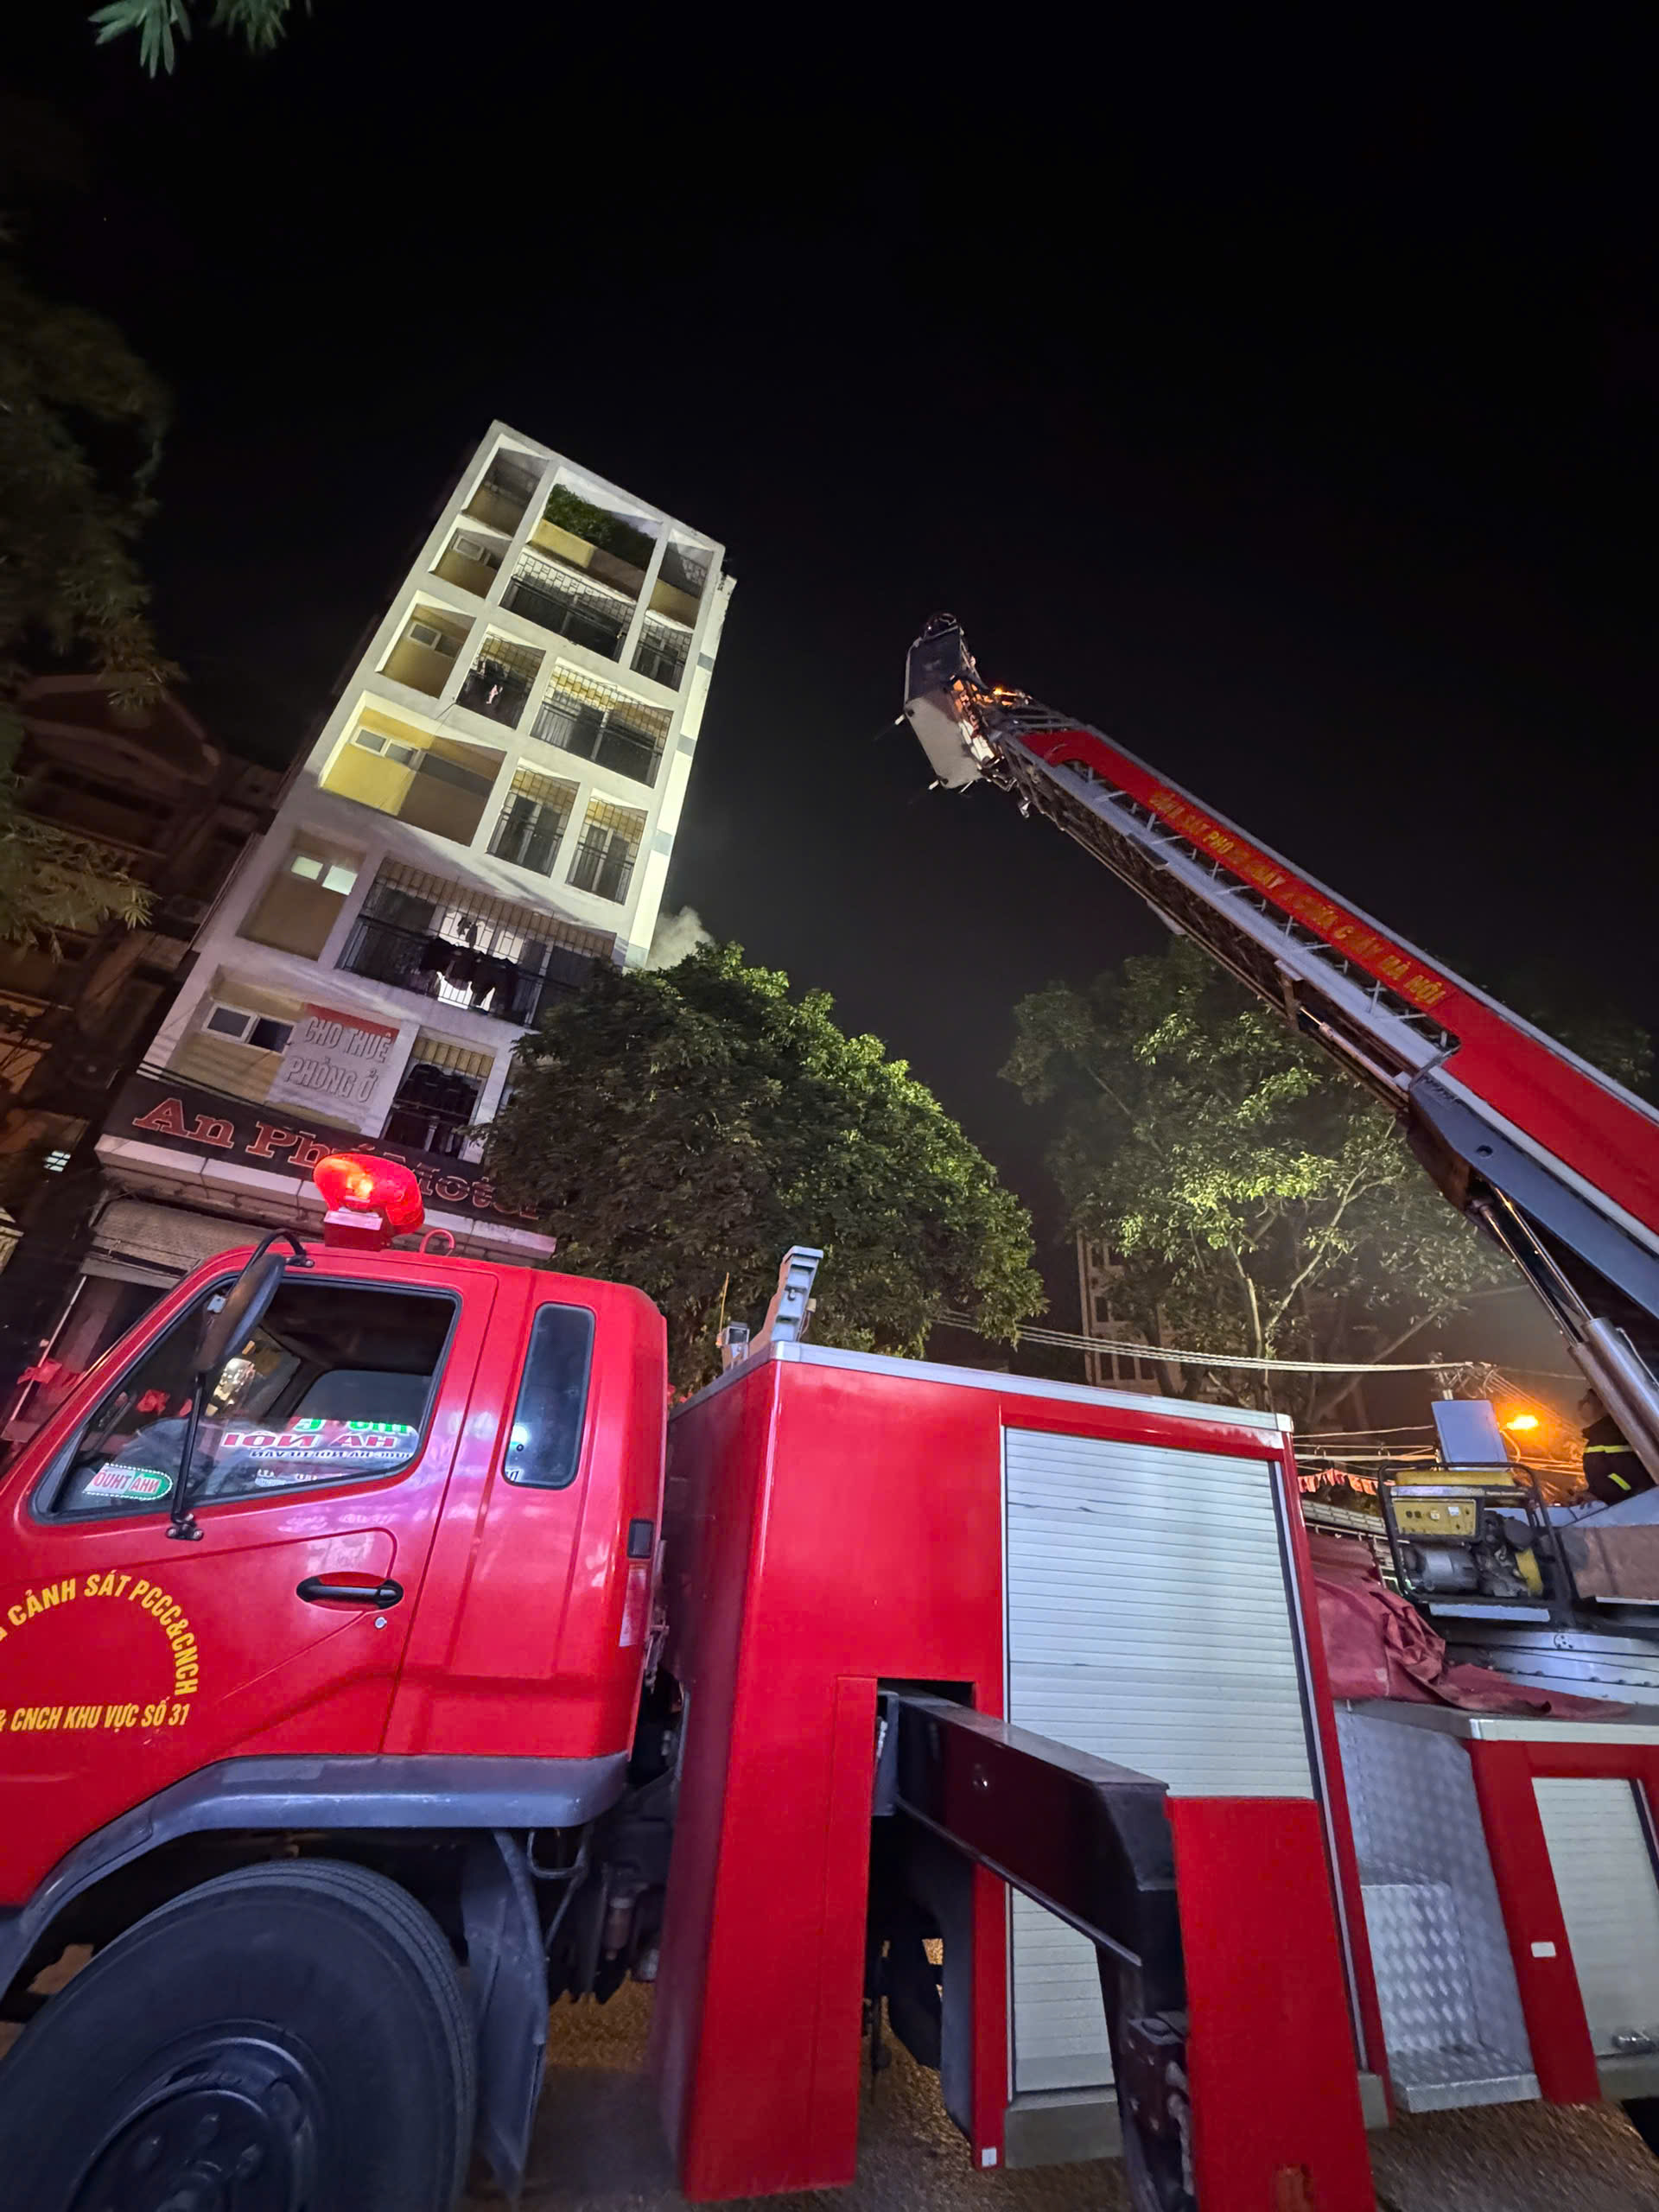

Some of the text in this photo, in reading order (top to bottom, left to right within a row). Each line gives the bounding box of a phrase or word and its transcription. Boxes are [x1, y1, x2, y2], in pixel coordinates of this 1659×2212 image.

[304, 1015, 392, 1064] CHO THUÊ
[131, 1097, 235, 1149] An
[7, 1569, 200, 1696] CẢNH SÁT PCCC&CNCH
[10, 1706, 63, 1732] CNCH
[62, 1705, 103, 1729] KHU
[104, 1702, 140, 1733] VỰC
[141, 1696, 171, 1727] SỐ
[168, 1703, 191, 1726] 31
